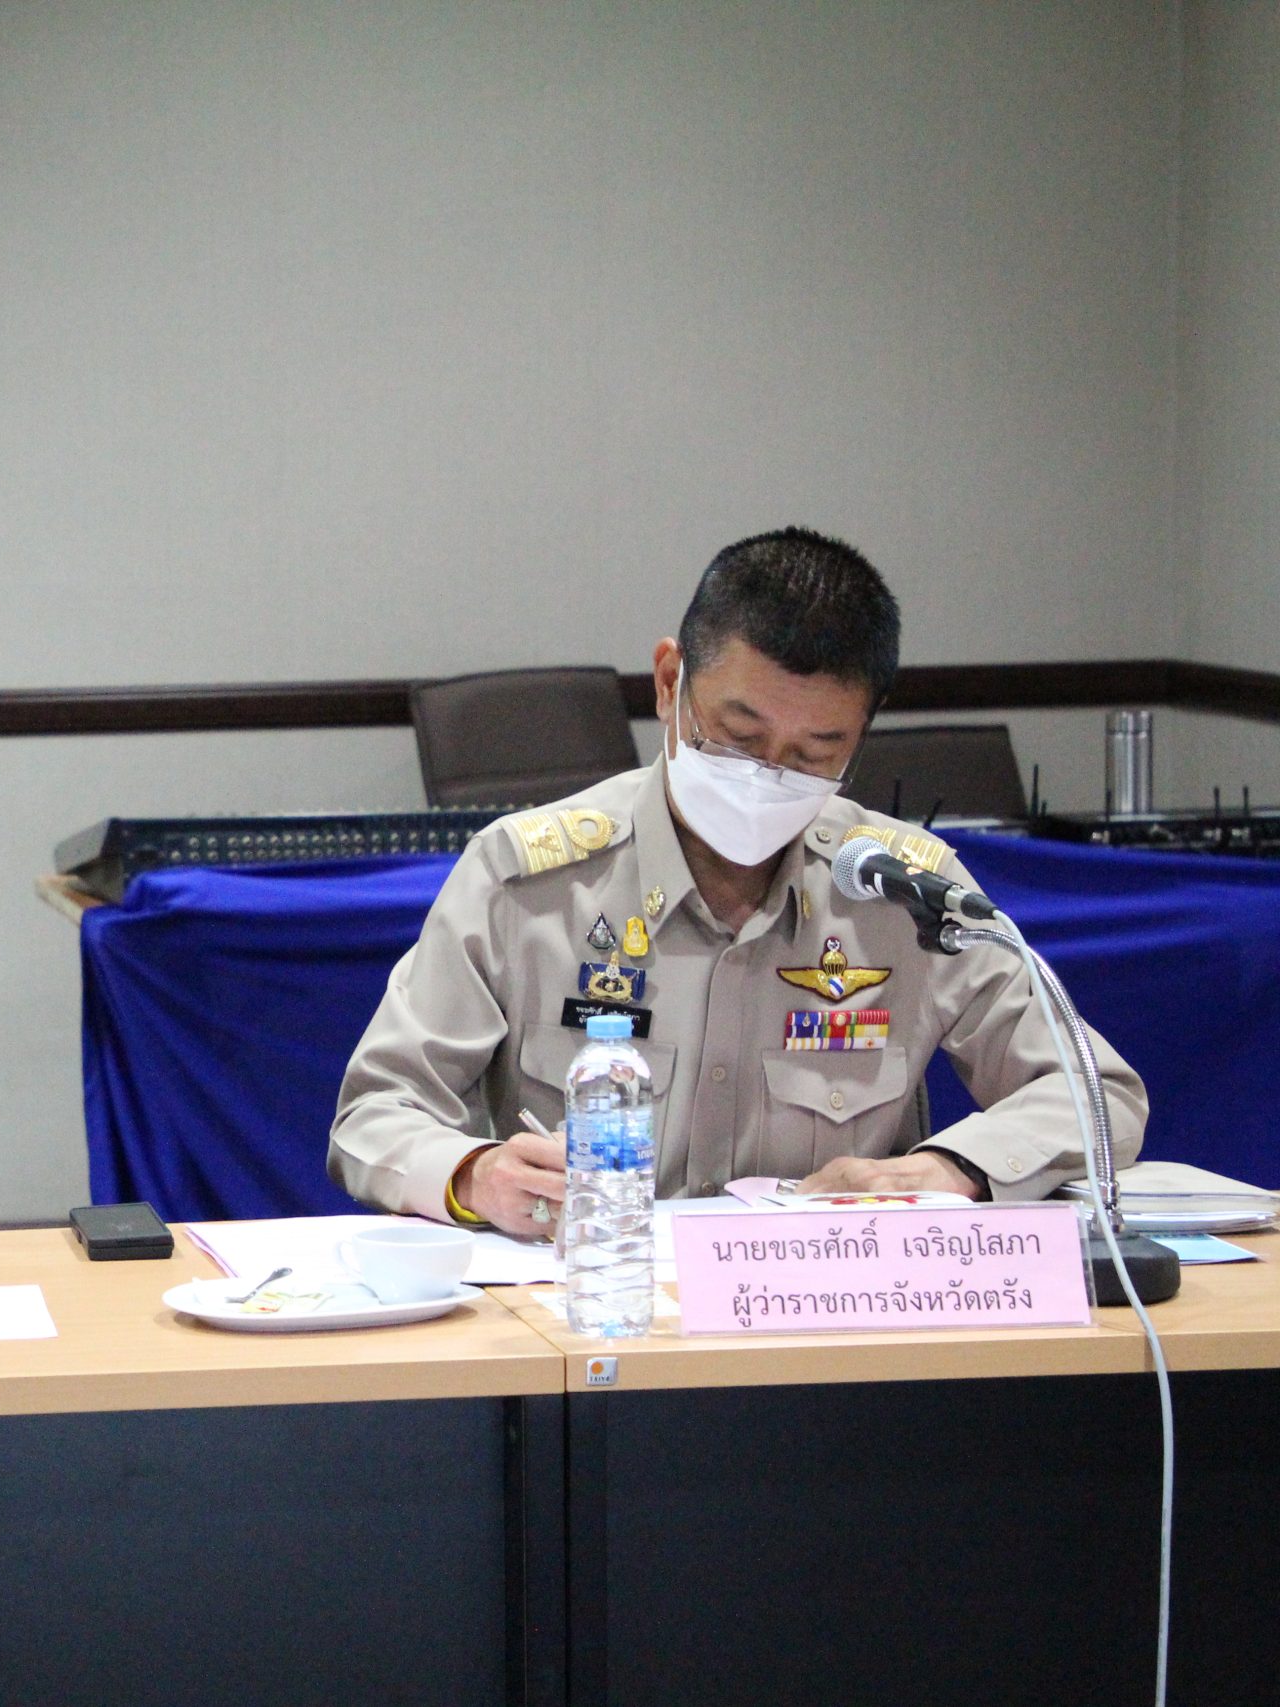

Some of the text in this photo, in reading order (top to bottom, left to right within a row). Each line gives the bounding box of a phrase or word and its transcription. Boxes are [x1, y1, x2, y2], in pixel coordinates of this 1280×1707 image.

[713, 1218, 1042, 1266] นายขจรศักดิ์ เจริญโสภา
[733, 1277, 1033, 1328] ผู้ว่าราชการจังหวัดตรัง
